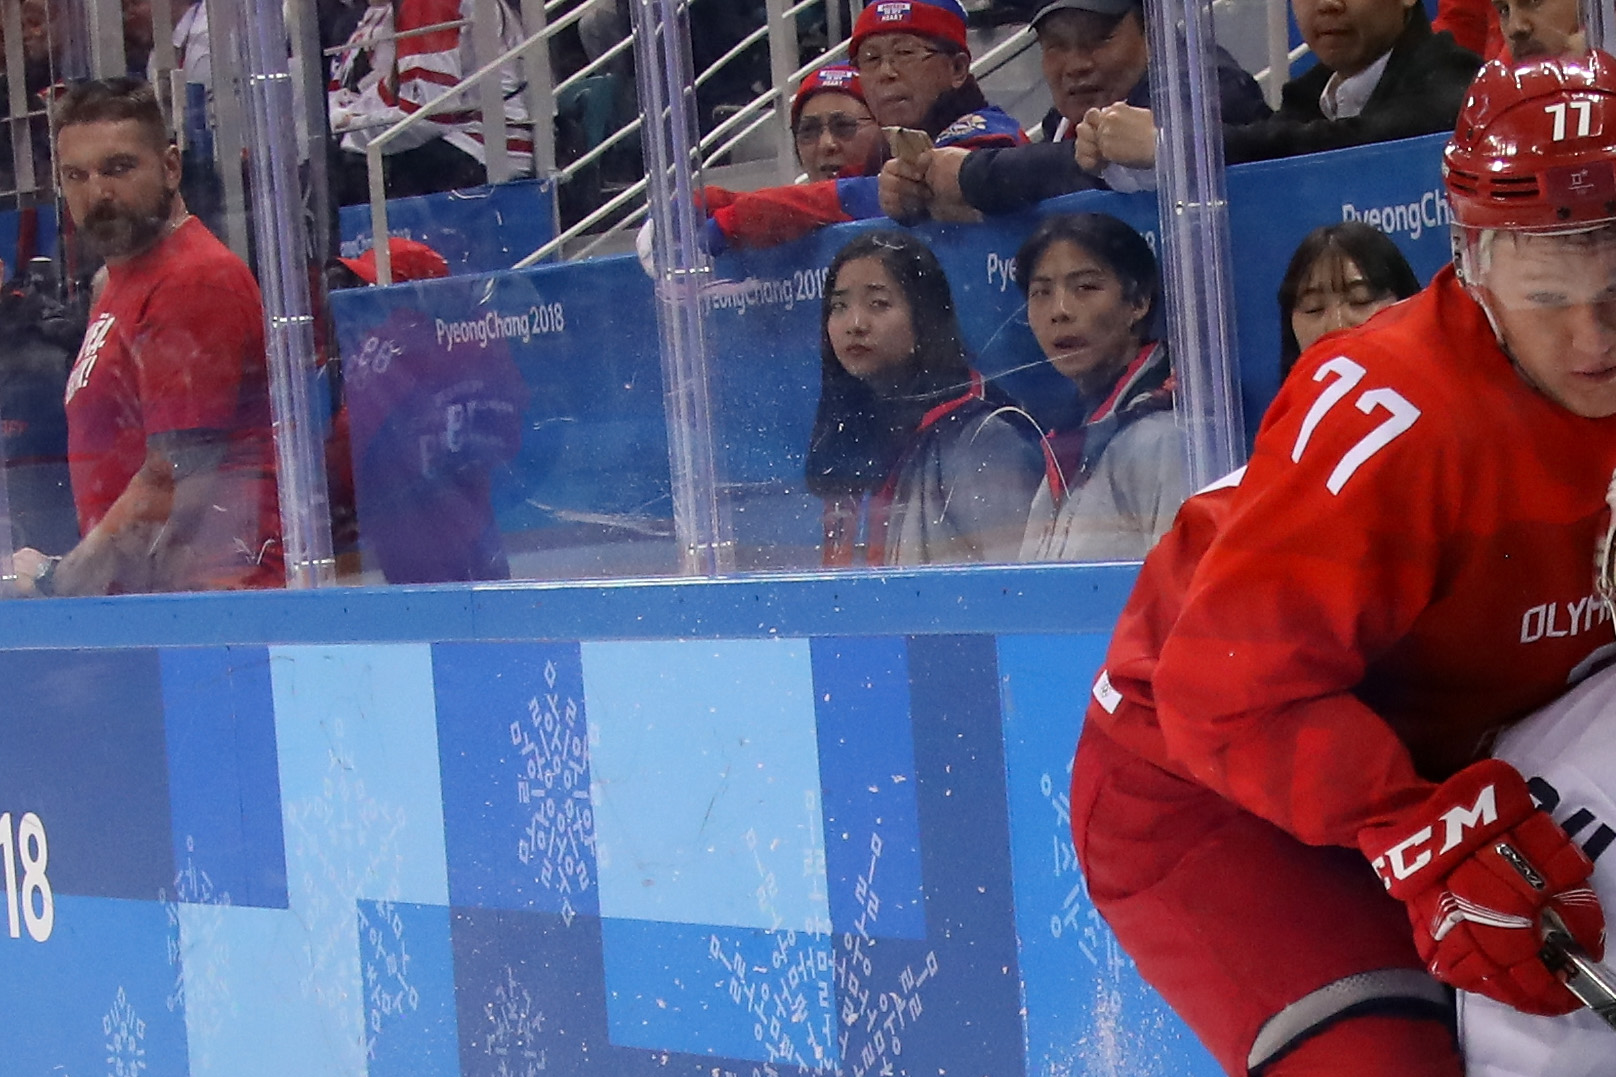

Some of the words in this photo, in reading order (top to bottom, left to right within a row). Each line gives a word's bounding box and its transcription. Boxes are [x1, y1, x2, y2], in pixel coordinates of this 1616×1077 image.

[1544, 100, 1592, 142] 77
[435, 310, 530, 351] PyeongChang
[532, 302, 564, 335] 2018
[1291, 355, 1422, 497] 77
